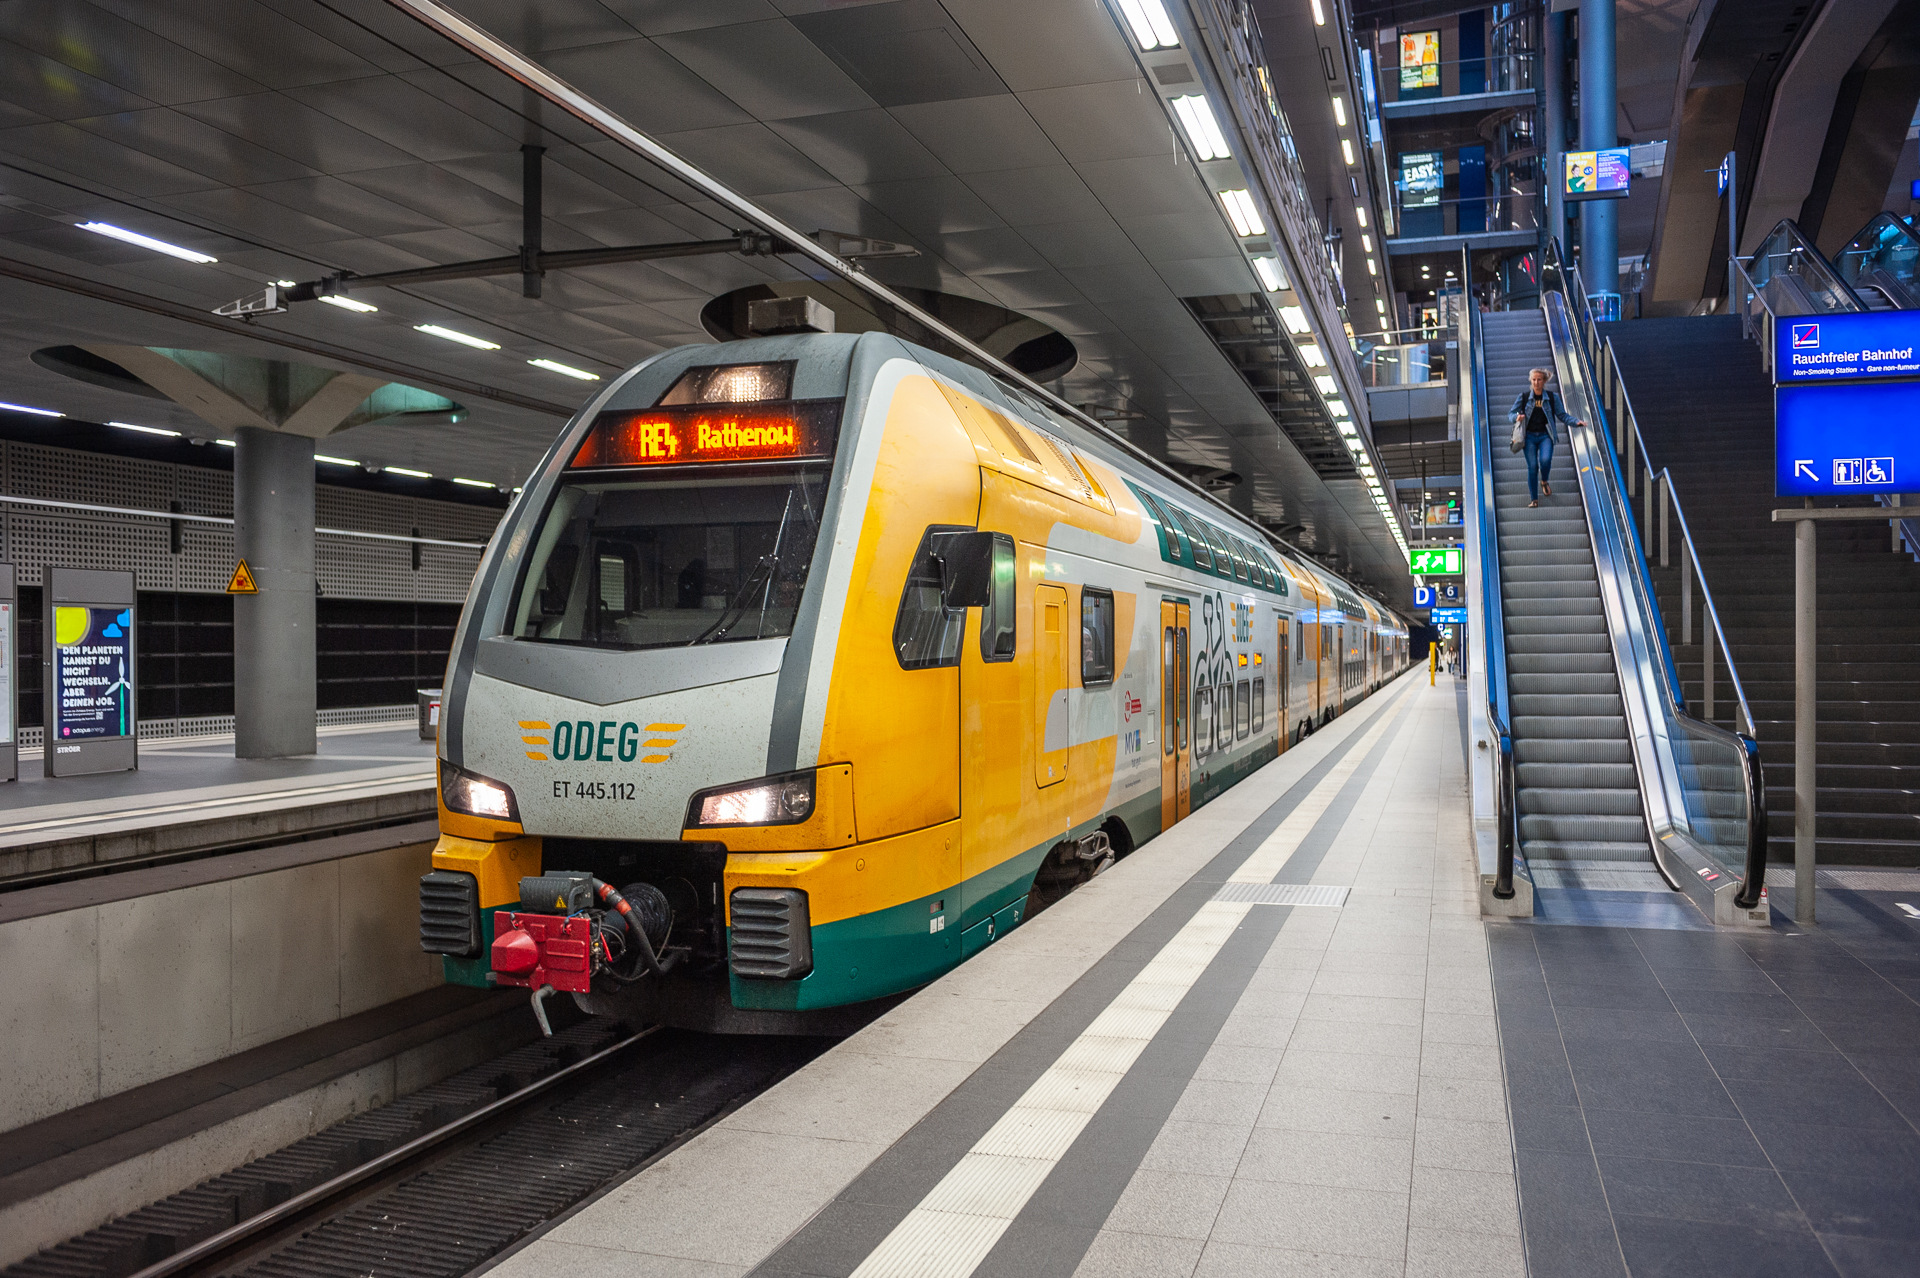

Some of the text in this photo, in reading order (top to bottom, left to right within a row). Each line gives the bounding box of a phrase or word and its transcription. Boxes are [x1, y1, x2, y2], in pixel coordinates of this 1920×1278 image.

[1404, 163, 1437, 183] EASY.
[1793, 347, 1913, 365] Rauchfreier Bahnhof
[1793, 367, 1835, 376] Non-Smoking
[1835, 366, 1858, 374] Station
[641, 422, 793, 457] RE4 Rathenow
[1416, 587, 1430, 605] D
[1447, 586, 1454, 597] 6
[63, 646, 123, 655] DEN PLANETEN
[63, 656, 111, 665] KANNST DU
[63, 666, 90, 676] NICHT
[63, 676, 111, 686] WECHSELN.
[63, 687, 85, 697] ABER
[63, 697, 115, 707] DEINEN JOB.
[552, 720, 639, 763] ODEG
[57, 745, 81, 753] STRÖER
[553, 781, 635, 800] ET 445.112
